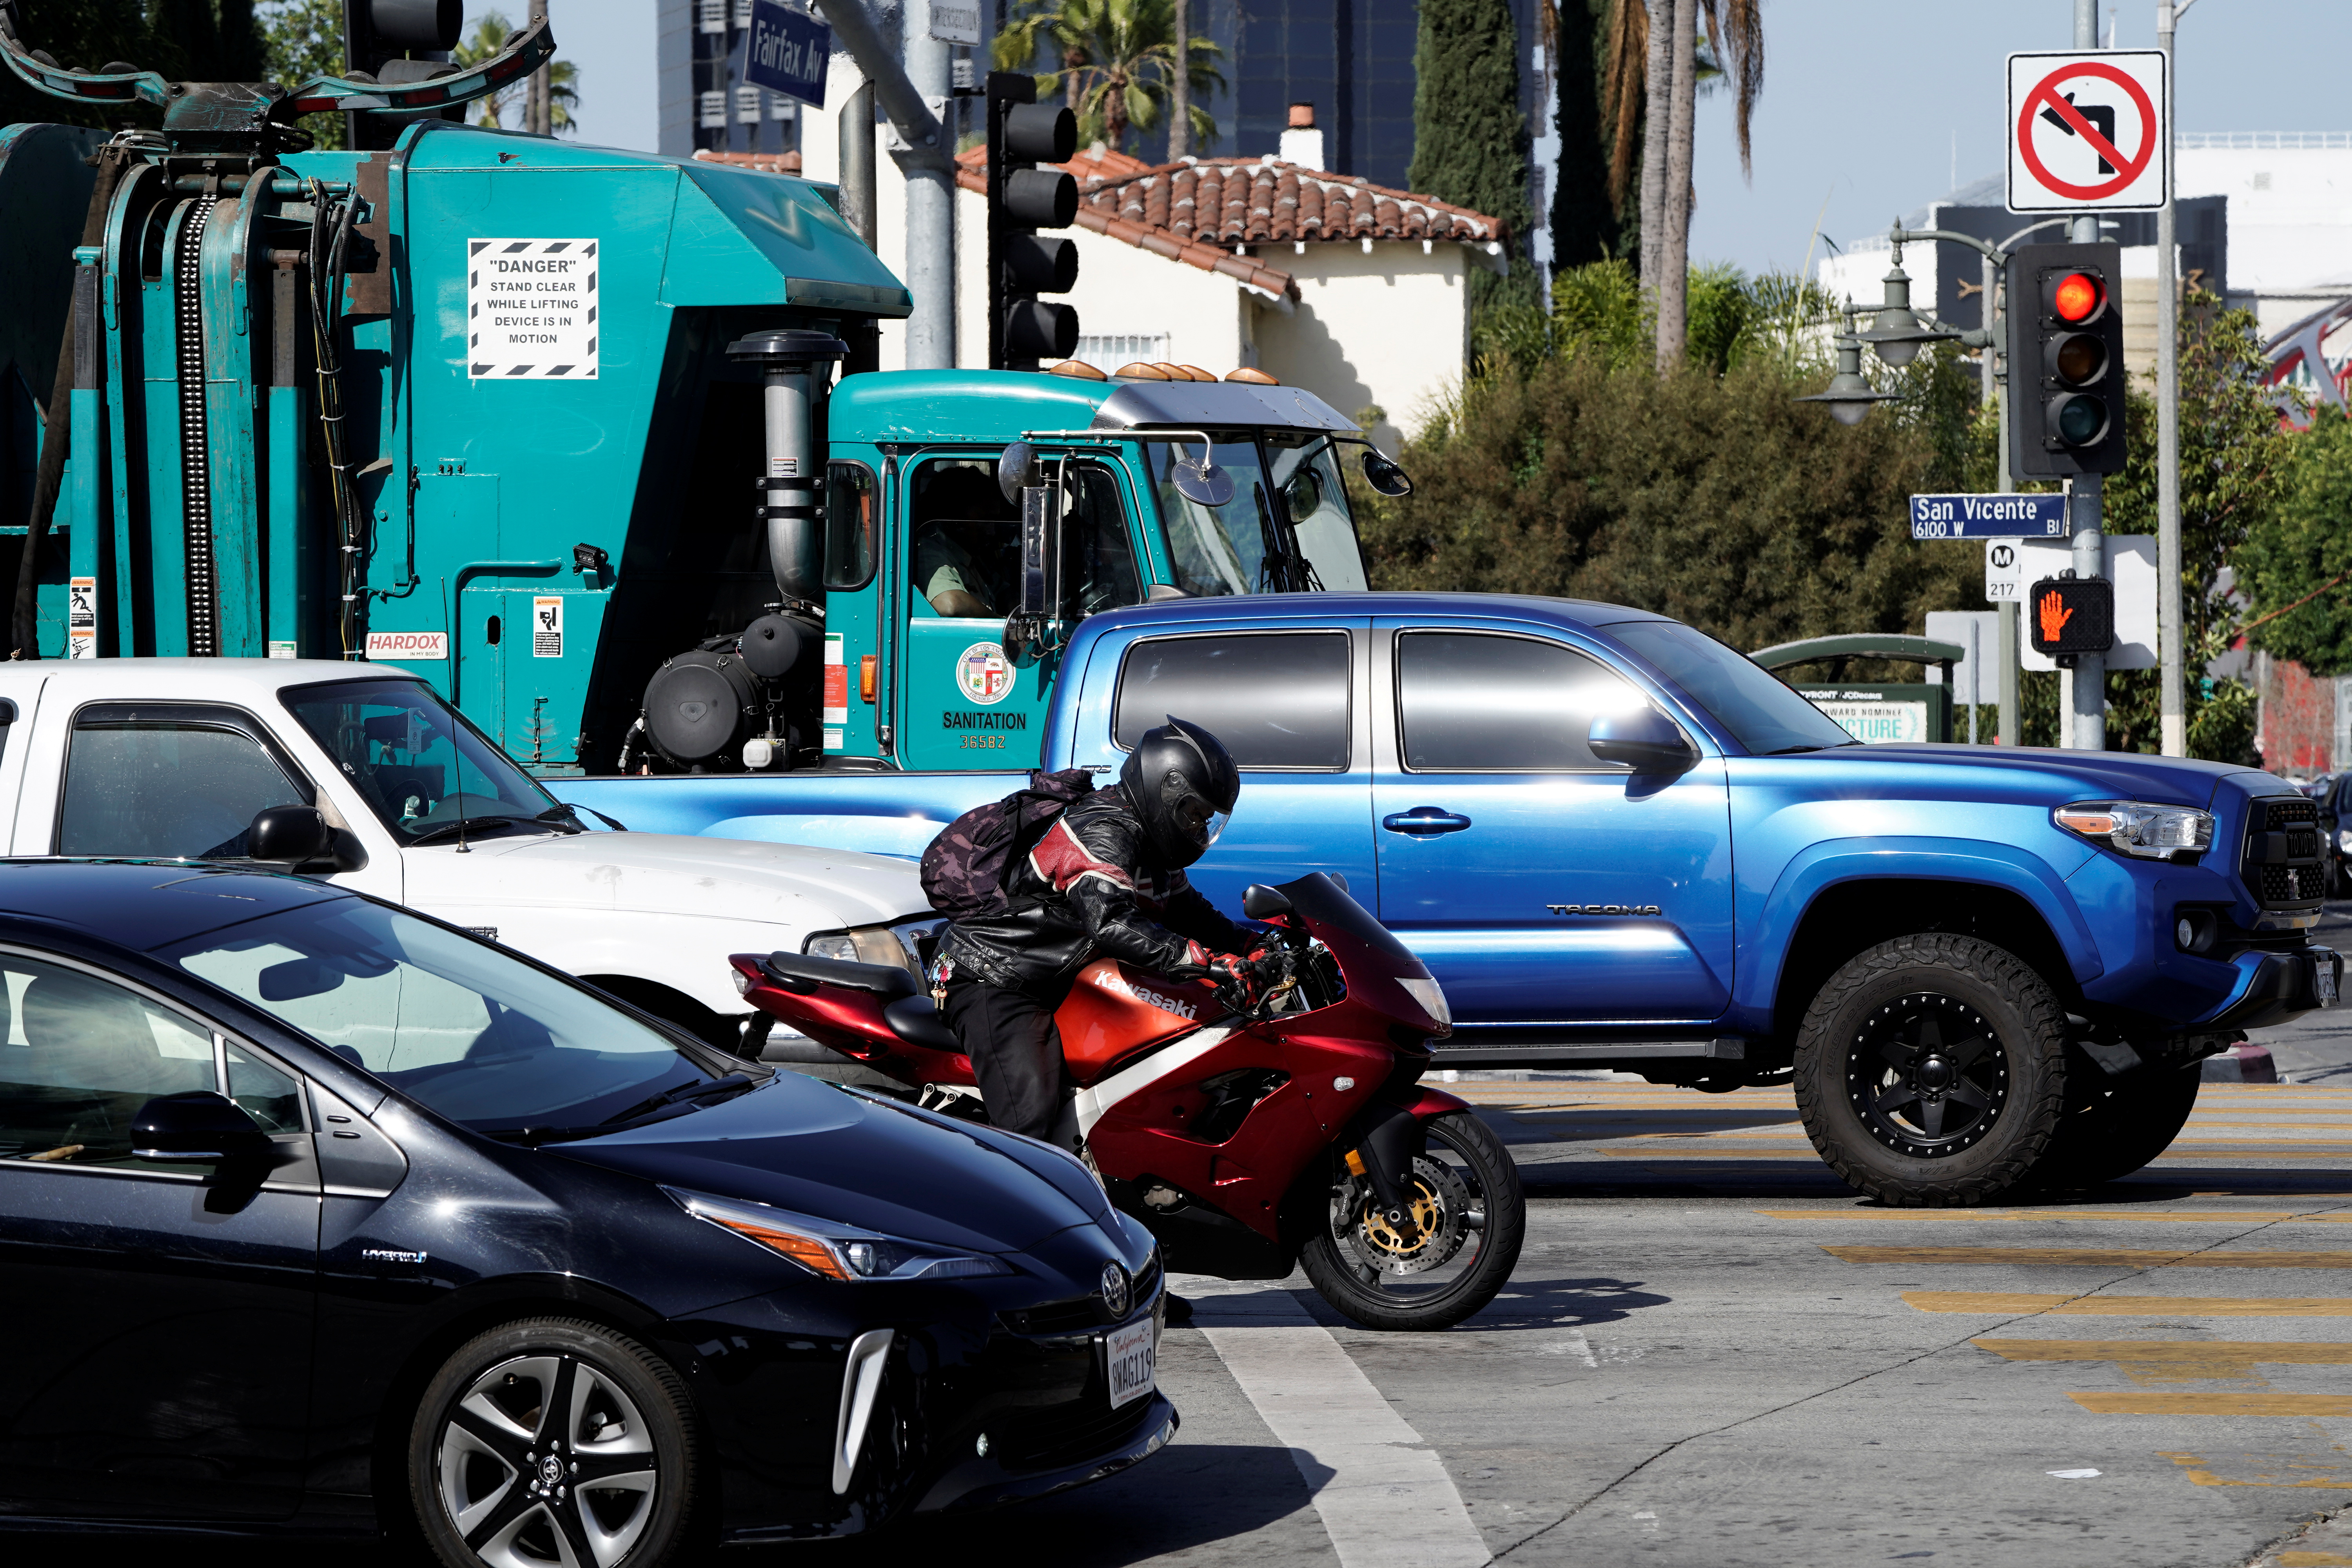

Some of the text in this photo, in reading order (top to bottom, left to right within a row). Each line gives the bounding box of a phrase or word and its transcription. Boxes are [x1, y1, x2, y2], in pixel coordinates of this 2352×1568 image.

[753, 19, 823, 83] Fairfax Av
[490, 260, 576, 273] "DANGER"
[490, 282, 576, 292] STAND CLEAR
[487, 299, 579, 309] WHILE LIFTING
[495, 317, 572, 326] DEVICE IS IN
[509, 334, 557, 343] MOTION
[1917, 497, 2037, 521] San Vicente
[1915, 521, 1947, 537] 6100
[1953, 521, 1965, 537] W
[1994, 548, 2012, 565] M
[1990, 583, 2014, 596] 217
[369, 635, 441, 649] HARDOX
[962, 652, 971, 663] CITY
[969, 691, 990, 701] FOUNDED
[1825, 708, 1901, 717] AWARD NOMINEE
[943, 711, 1026, 730] SANITATION
[960, 735, 1005, 749] 36582
[2288, 833, 2317, 855] TOYOTA
[1546, 904, 1662, 916] TACOMA
[1094, 971, 1198, 1021] Kawasaki
[1918, 1164, 1955, 1176] T/A
[362, 1249, 418, 1262] HYBRID
[1116, 1333, 1145, 1355] California
[1112, 1347, 1152, 1396] 8WAG119
[1120, 1387, 1143, 1401] dmv.ca.gov
